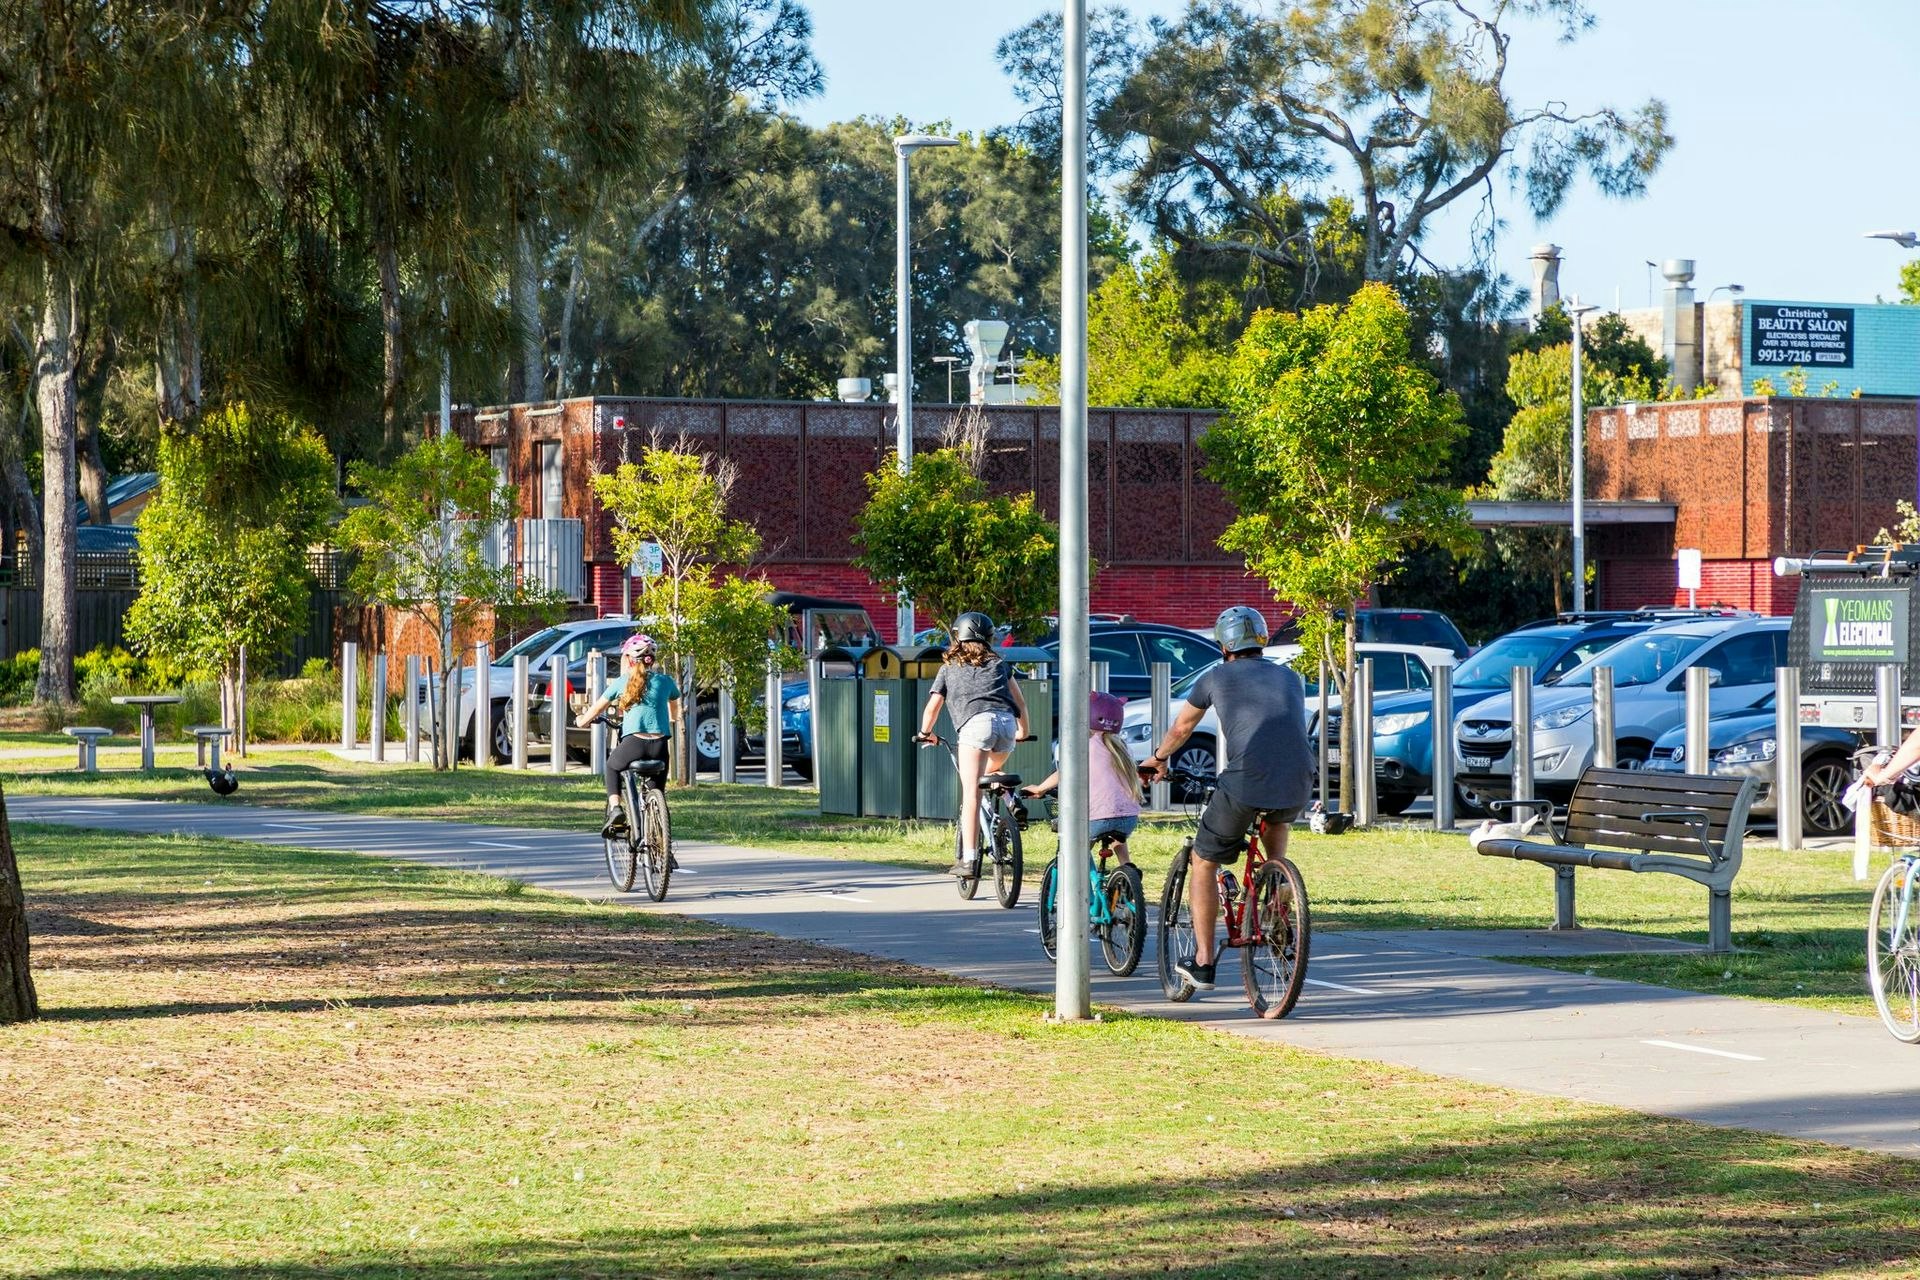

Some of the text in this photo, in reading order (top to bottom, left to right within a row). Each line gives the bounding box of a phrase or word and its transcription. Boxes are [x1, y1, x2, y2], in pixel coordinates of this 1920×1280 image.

[1777, 308, 1828, 318] Christine's
[1758, 318, 1847, 332] BEAUTY SALON
[1766, 332, 1841, 341] ELECTROLYSIS SPECIALIST
[1758, 349, 1812, 362] 9913-7216
[1840, 600, 1893, 621] YEOMANS
[1839, 622, 1894, 645] ELECTRICAL
